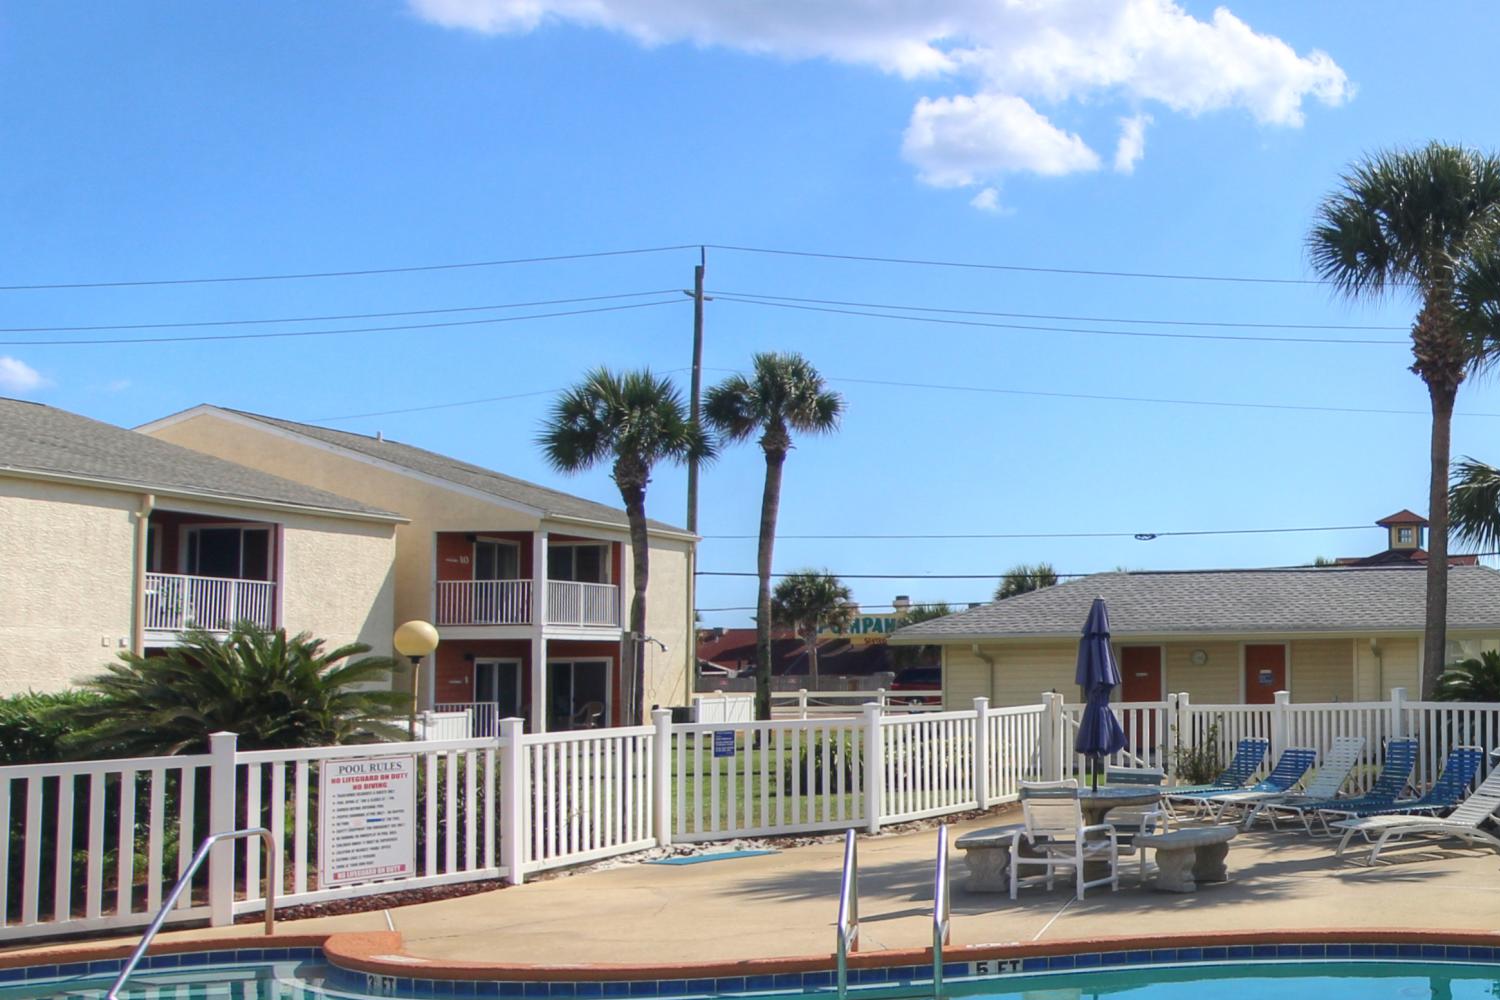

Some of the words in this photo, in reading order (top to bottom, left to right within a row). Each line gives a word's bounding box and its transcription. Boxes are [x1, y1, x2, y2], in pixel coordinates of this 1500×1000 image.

[338, 764, 367, 774] POOL
[369, 761, 402, 772] RULES
[342, 775, 379, 783] LIFEGUARD
[363, 782, 388, 790] DIVING
[976, 962, 988, 973] 5
[998, 960, 1020, 973] FT
